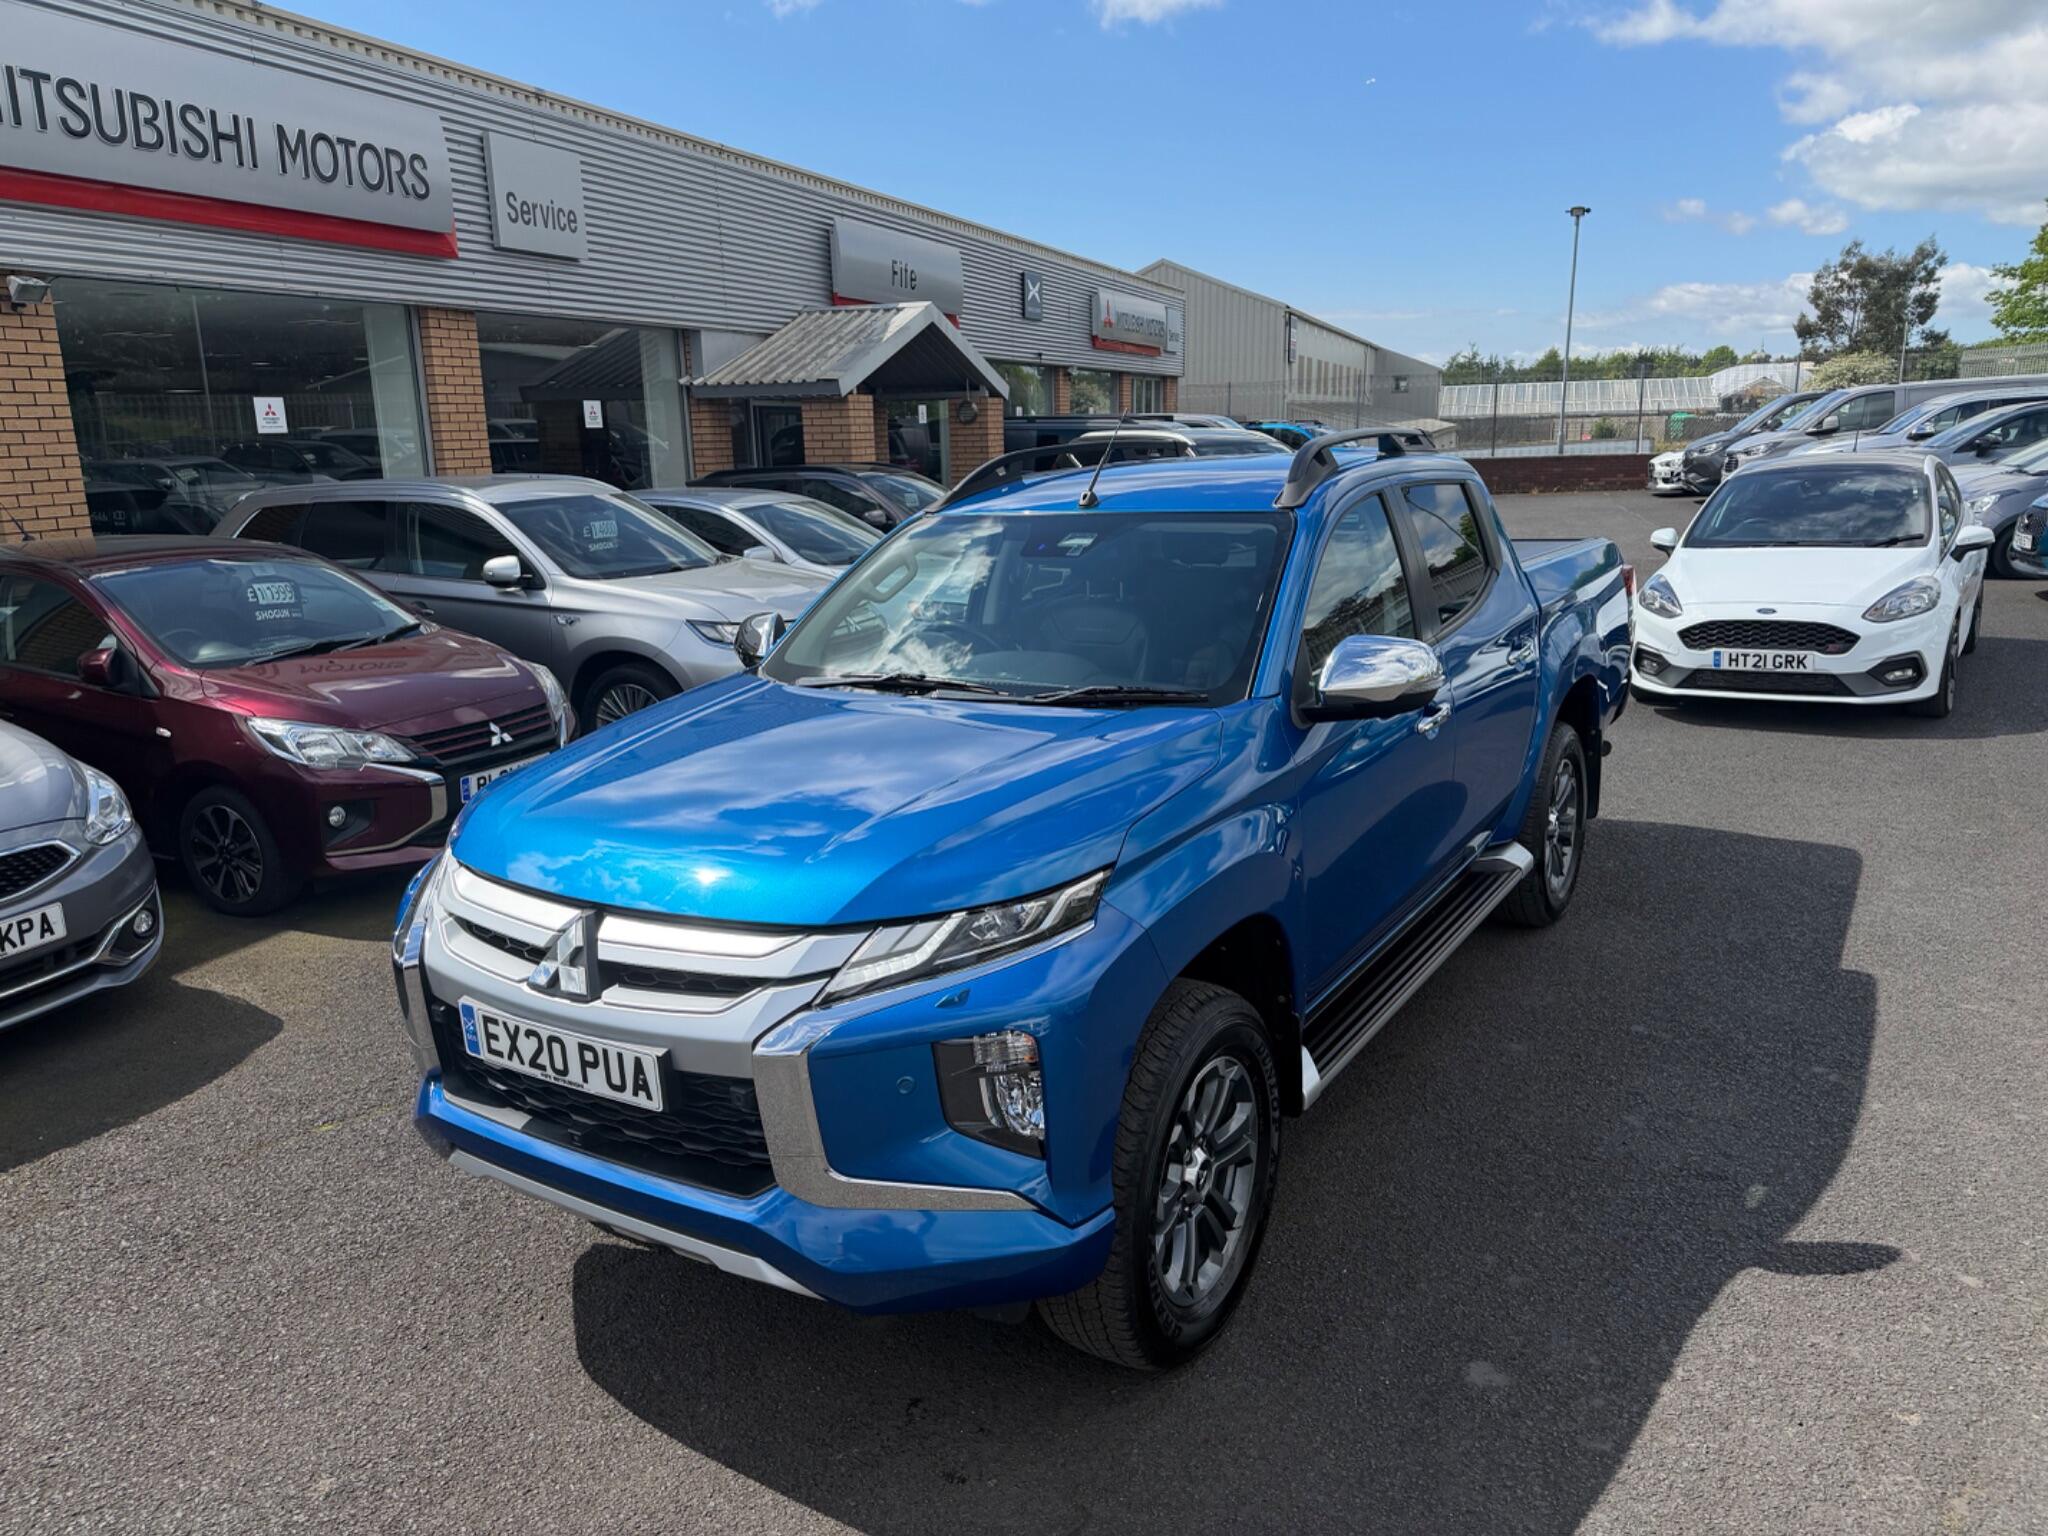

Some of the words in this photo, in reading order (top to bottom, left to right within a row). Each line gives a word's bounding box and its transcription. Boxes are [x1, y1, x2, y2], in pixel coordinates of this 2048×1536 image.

[0, 65, 259, 169] ITSUBISHI
[275, 122, 431, 200] MOTORS
[505, 191, 578, 233] Service
[1728, 653, 1767, 670] HT21
[1772, 654, 1808, 670] GRK
[0, 911, 56, 952] KPA
[481, 1013, 570, 1077] EX20
[577, 1041, 654, 1101] PUA
